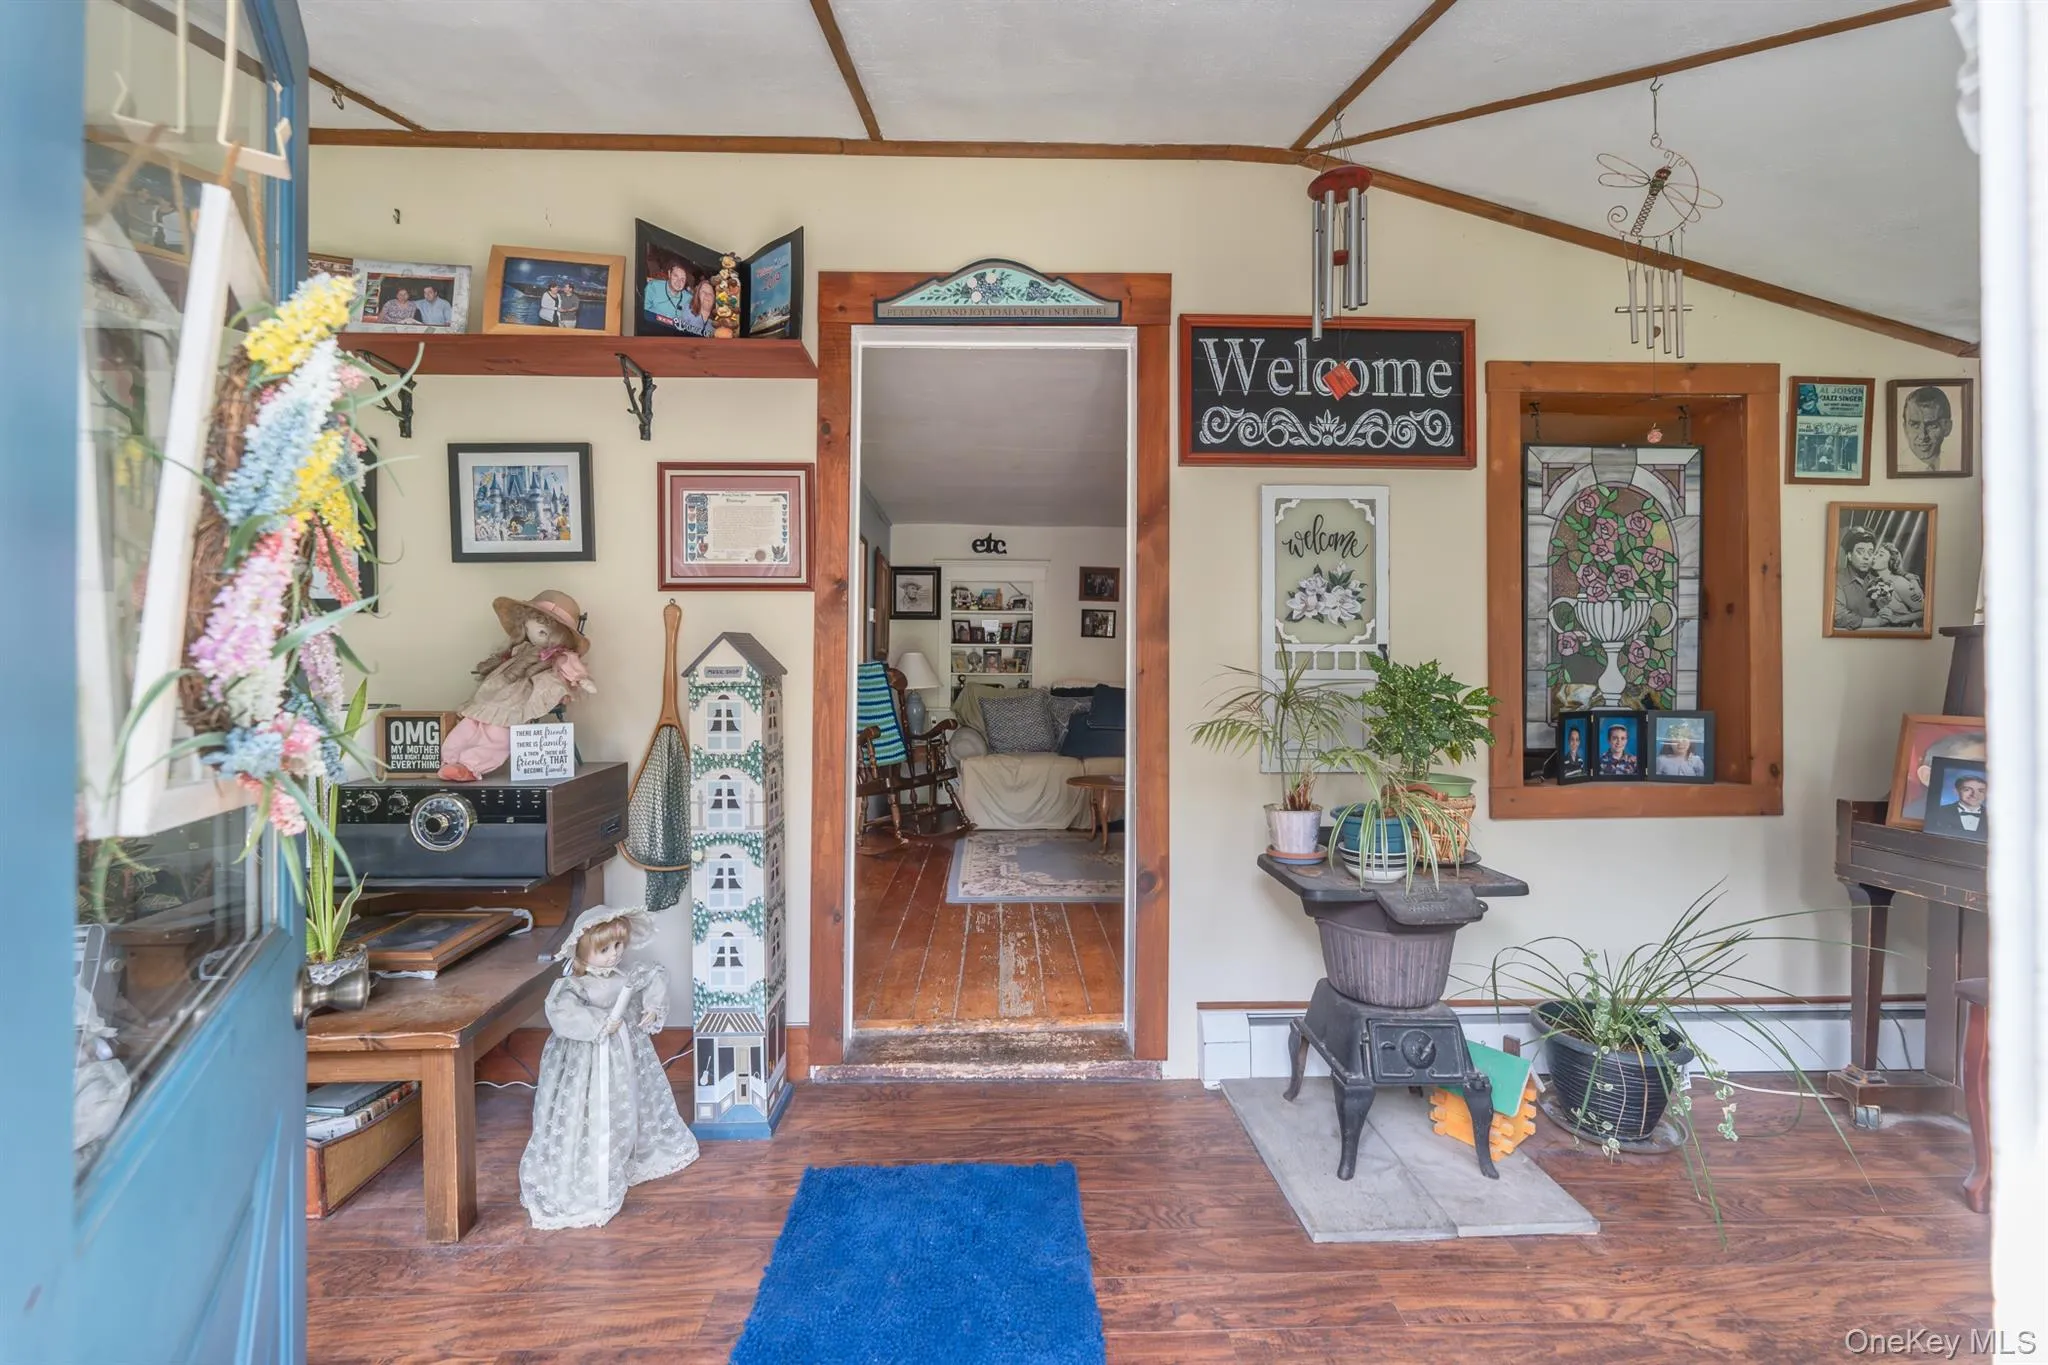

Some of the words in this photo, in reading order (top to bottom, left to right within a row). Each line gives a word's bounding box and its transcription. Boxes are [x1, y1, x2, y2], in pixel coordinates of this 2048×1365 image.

[945, 308, 966, 317] AND
[968, 308, 987, 317] JOY
[1198, 337, 1453, 398] Welcome
[1281, 514, 1369, 559] welcome
[390, 721, 440, 745] OMG
[544, 726, 568, 739] friends
[390, 745, 404, 754] MY
[406, 745, 440, 754] MOTHER
[539, 735, 567, 751] family
[390, 760, 440, 769] EVERYTHING
[516, 754, 547, 772] friends
[550, 755, 568, 765] THAT
[523, 767, 544, 775] BECOME
